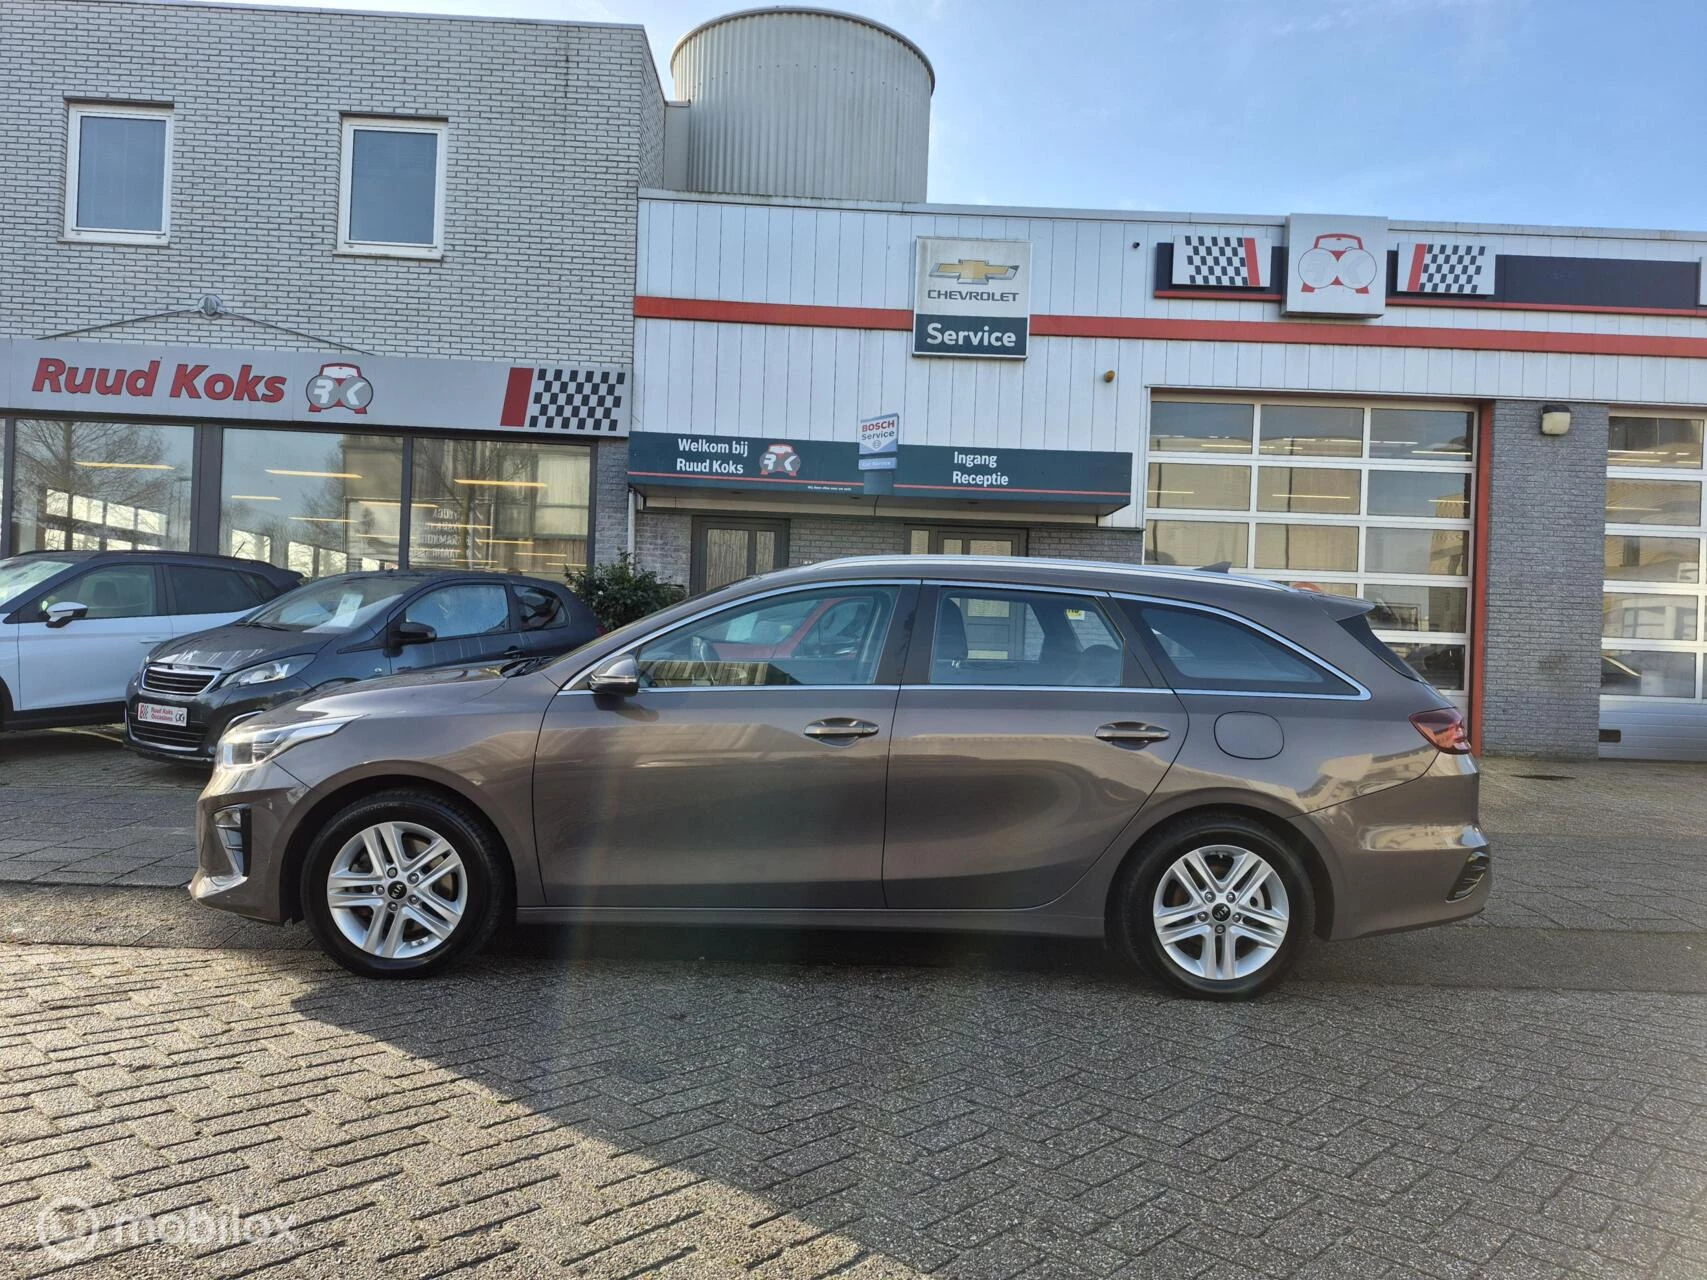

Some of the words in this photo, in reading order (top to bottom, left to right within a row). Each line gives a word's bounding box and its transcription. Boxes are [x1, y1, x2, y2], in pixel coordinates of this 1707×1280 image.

[927, 289, 1020, 302] CHEVROLET
[926, 322, 1017, 347] Service
[31, 357, 161, 397] Ruud
[169, 363, 287, 403] Koks
[861, 419, 895, 433] BOSCH
[861, 430, 895, 441] Service
[677, 437, 730, 454] Welkom
[732, 440, 748, 458] bij
[676, 457, 710, 473] Ruud
[712, 459, 744, 475] Koks
[953, 451, 998, 468] Ingang
[952, 470, 1009, 487] Receptie
